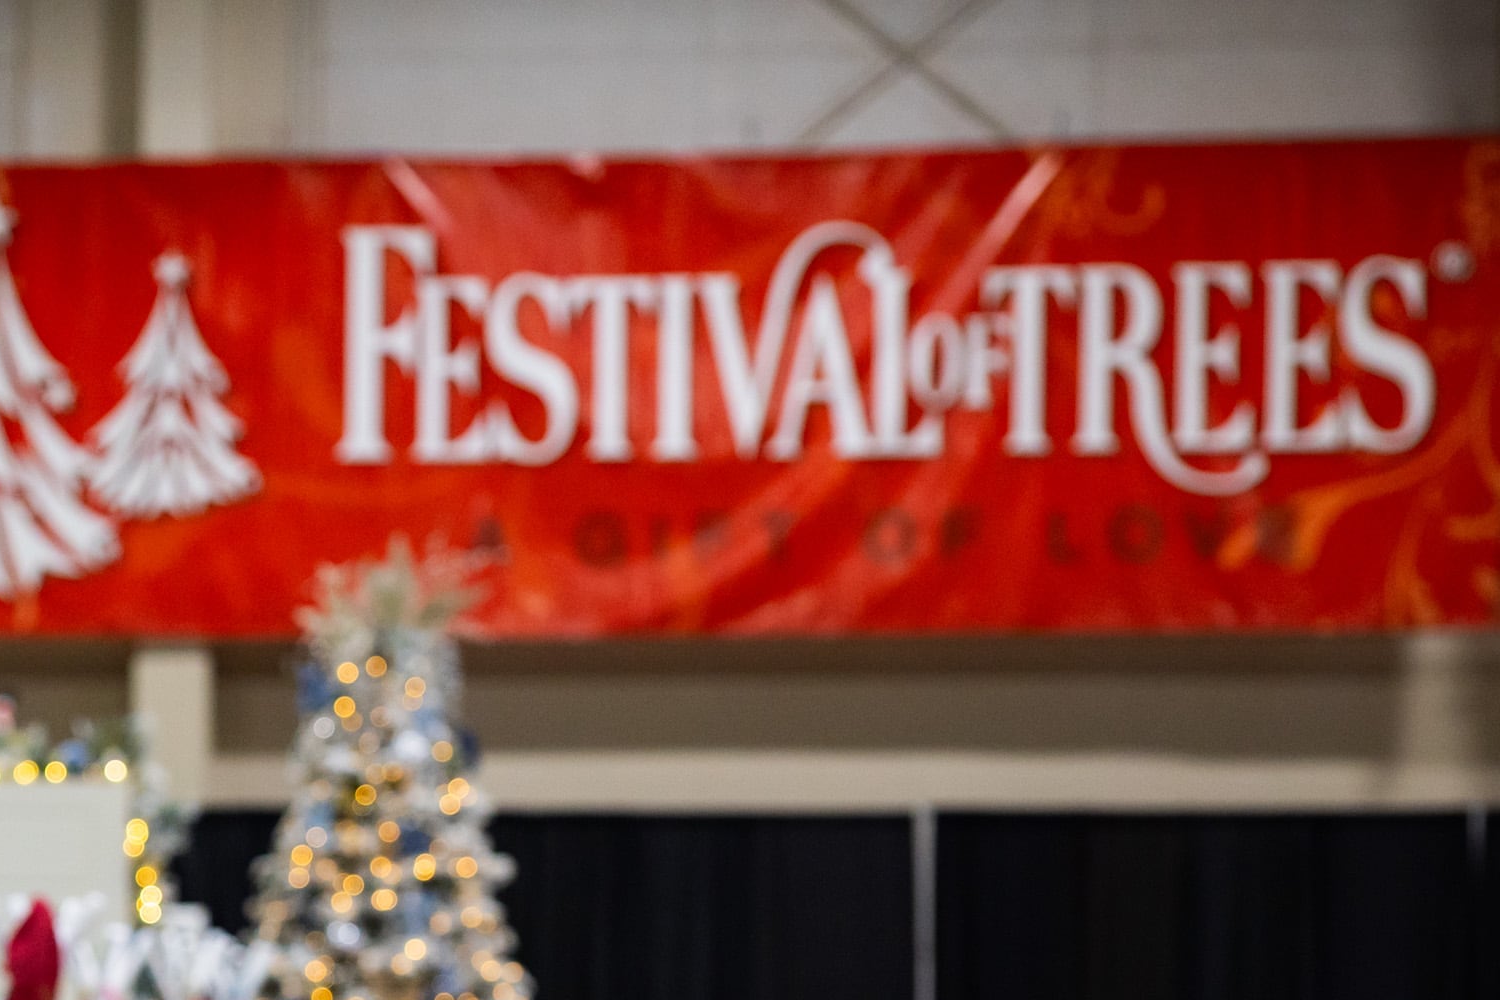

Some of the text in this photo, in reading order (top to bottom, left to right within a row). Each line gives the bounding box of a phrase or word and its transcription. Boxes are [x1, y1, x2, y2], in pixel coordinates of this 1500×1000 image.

[332, 218, 1438, 496] FESTIVAL OF TREES
